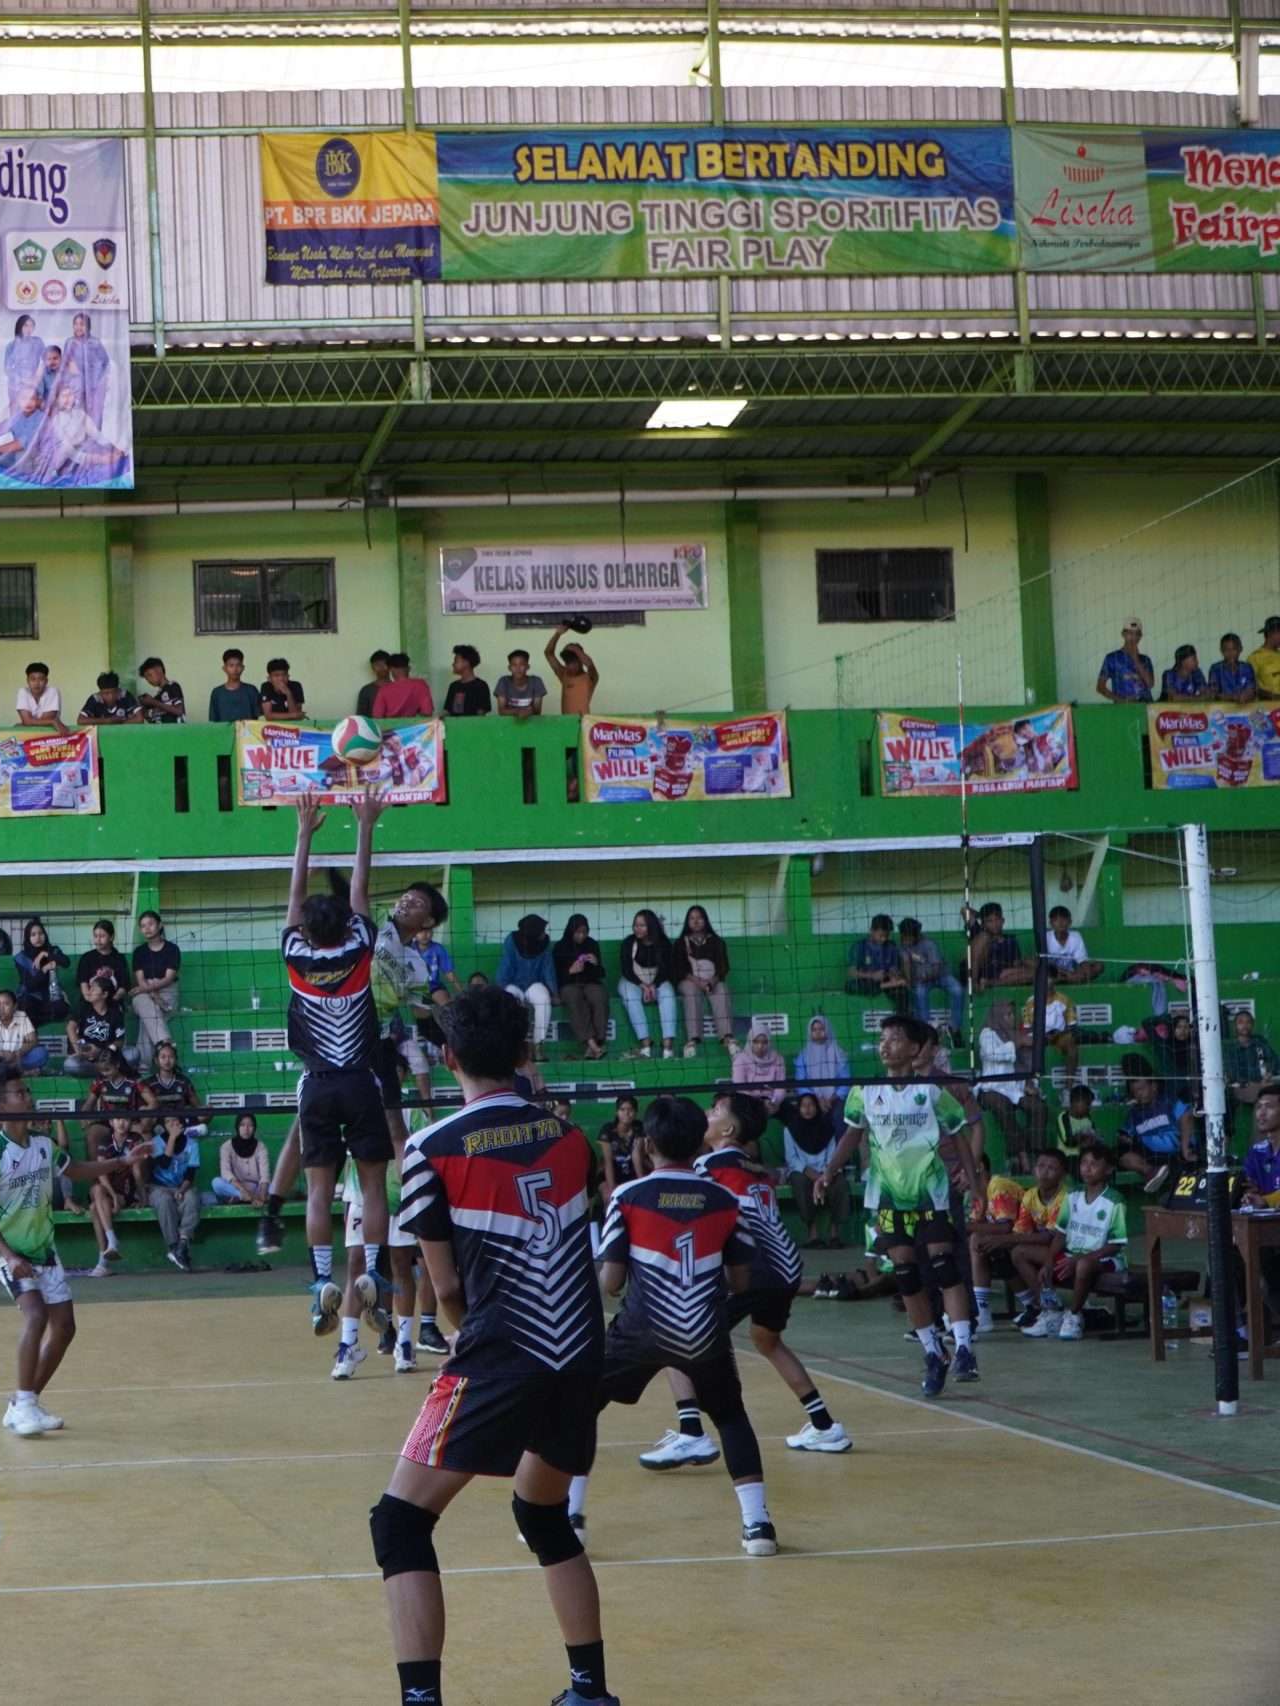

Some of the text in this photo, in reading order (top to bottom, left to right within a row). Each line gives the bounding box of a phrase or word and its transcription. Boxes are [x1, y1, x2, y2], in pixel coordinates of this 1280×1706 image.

[516, 141, 947, 183] SELAMAT BERTANDING
[265, 203, 435, 224] PT. BPR BKK JEPARA
[464, 199, 1000, 234] JUNJUNG TINGGI SPORTIFITAS
[1031, 187, 1135, 226] Lischa
[650, 237, 831, 269] FAIR PLAY
[474, 562, 680, 592] KELAS KHUSUS OLAHRGA
[593, 729, 642, 742] MariMas
[886, 737, 955, 761] WILLIE
[246, 747, 315, 770] WILLIE
[594, 761, 649, 781] WILLIE
[1175, 1176, 1196, 1195] 22
[513, 1168, 562, 1256] 5
[674, 1231, 695, 1288] 1
